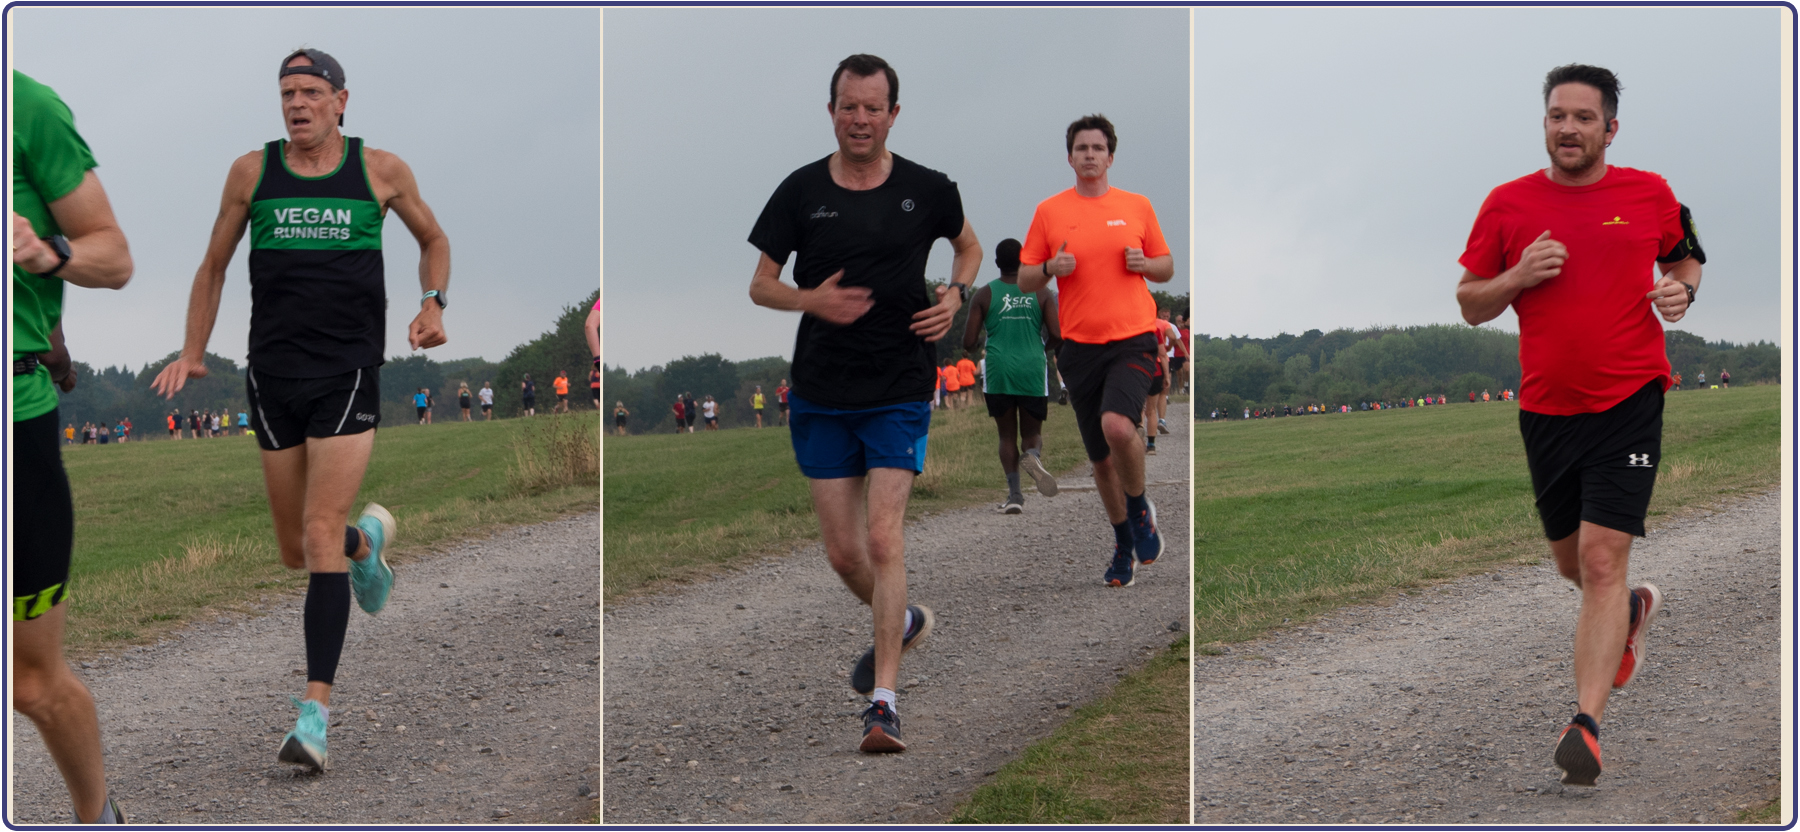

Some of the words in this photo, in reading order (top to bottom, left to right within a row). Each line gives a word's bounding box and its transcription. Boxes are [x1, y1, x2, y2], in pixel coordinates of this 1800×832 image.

[273, 207, 352, 225] VEGAN
[273, 226, 351, 240] RUNNERS
[1012, 296, 1034, 304] src
